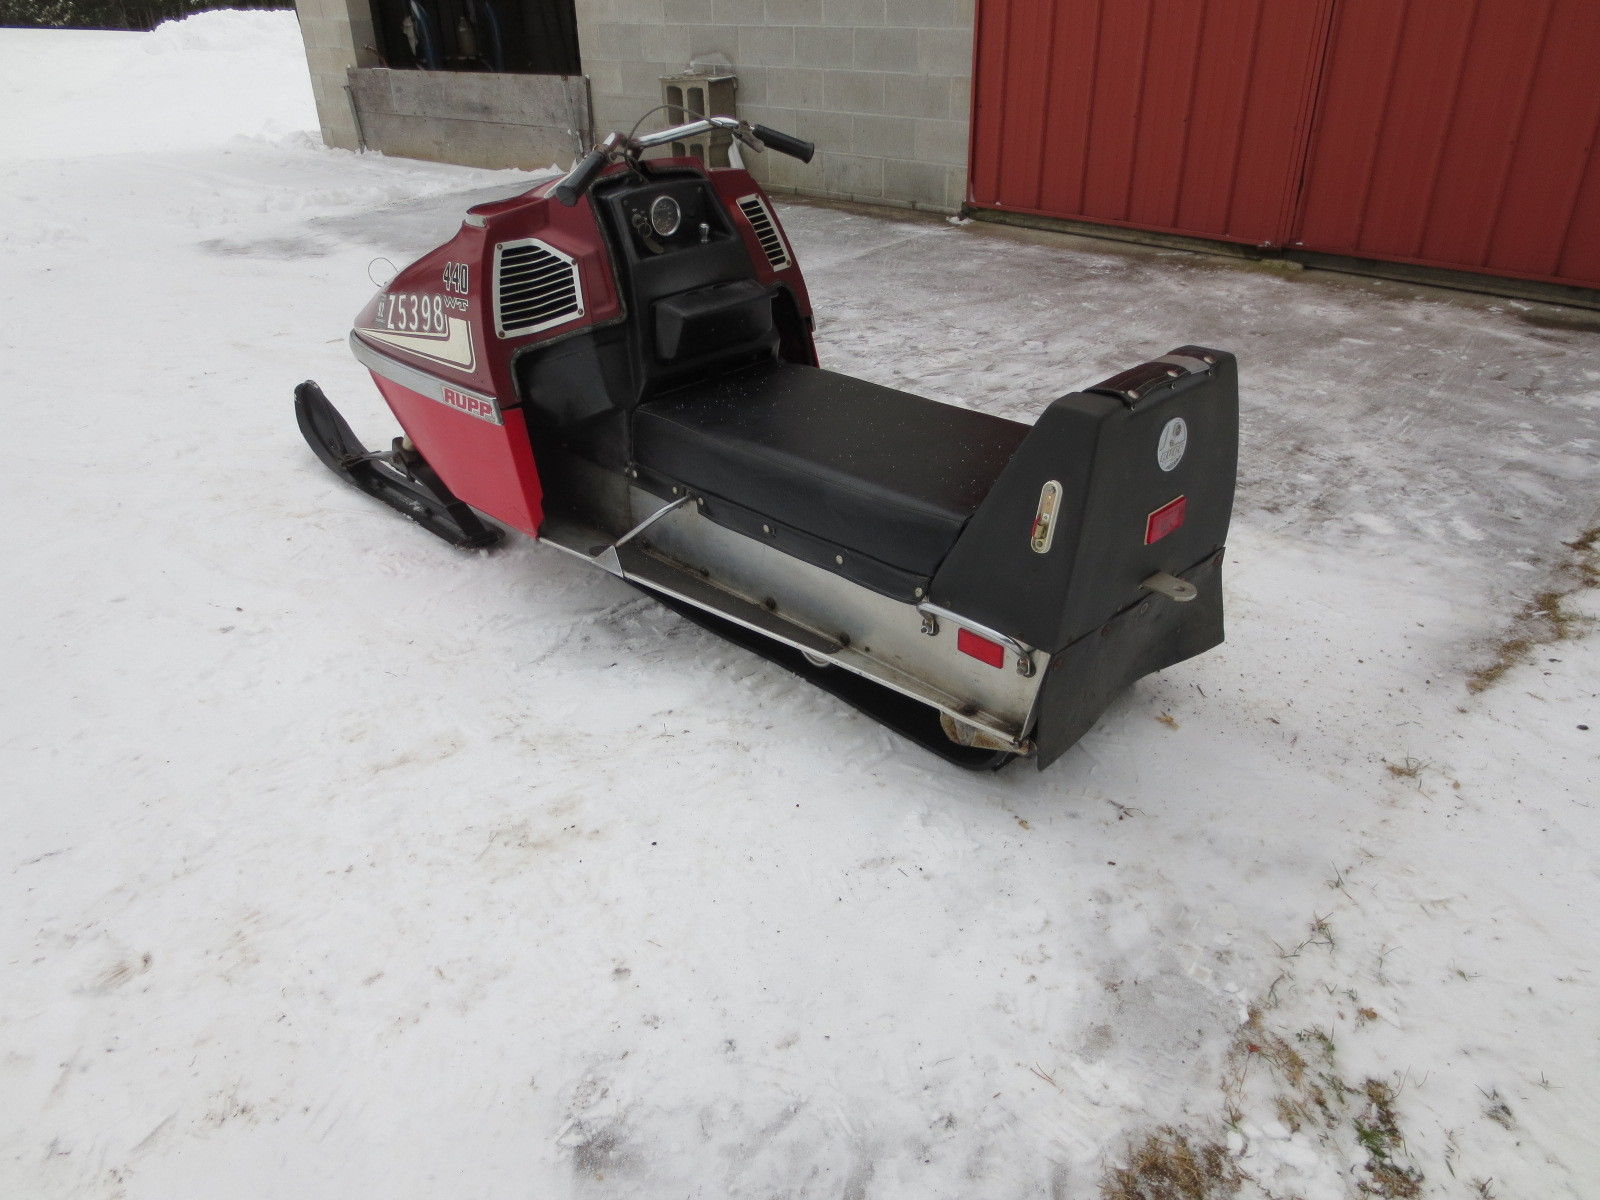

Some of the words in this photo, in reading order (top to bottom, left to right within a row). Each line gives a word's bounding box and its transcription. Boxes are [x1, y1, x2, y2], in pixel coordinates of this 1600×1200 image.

[443, 261, 469, 295] 440
[387, 294, 444, 331] Z5398
[444, 388, 493, 417] RUPP
